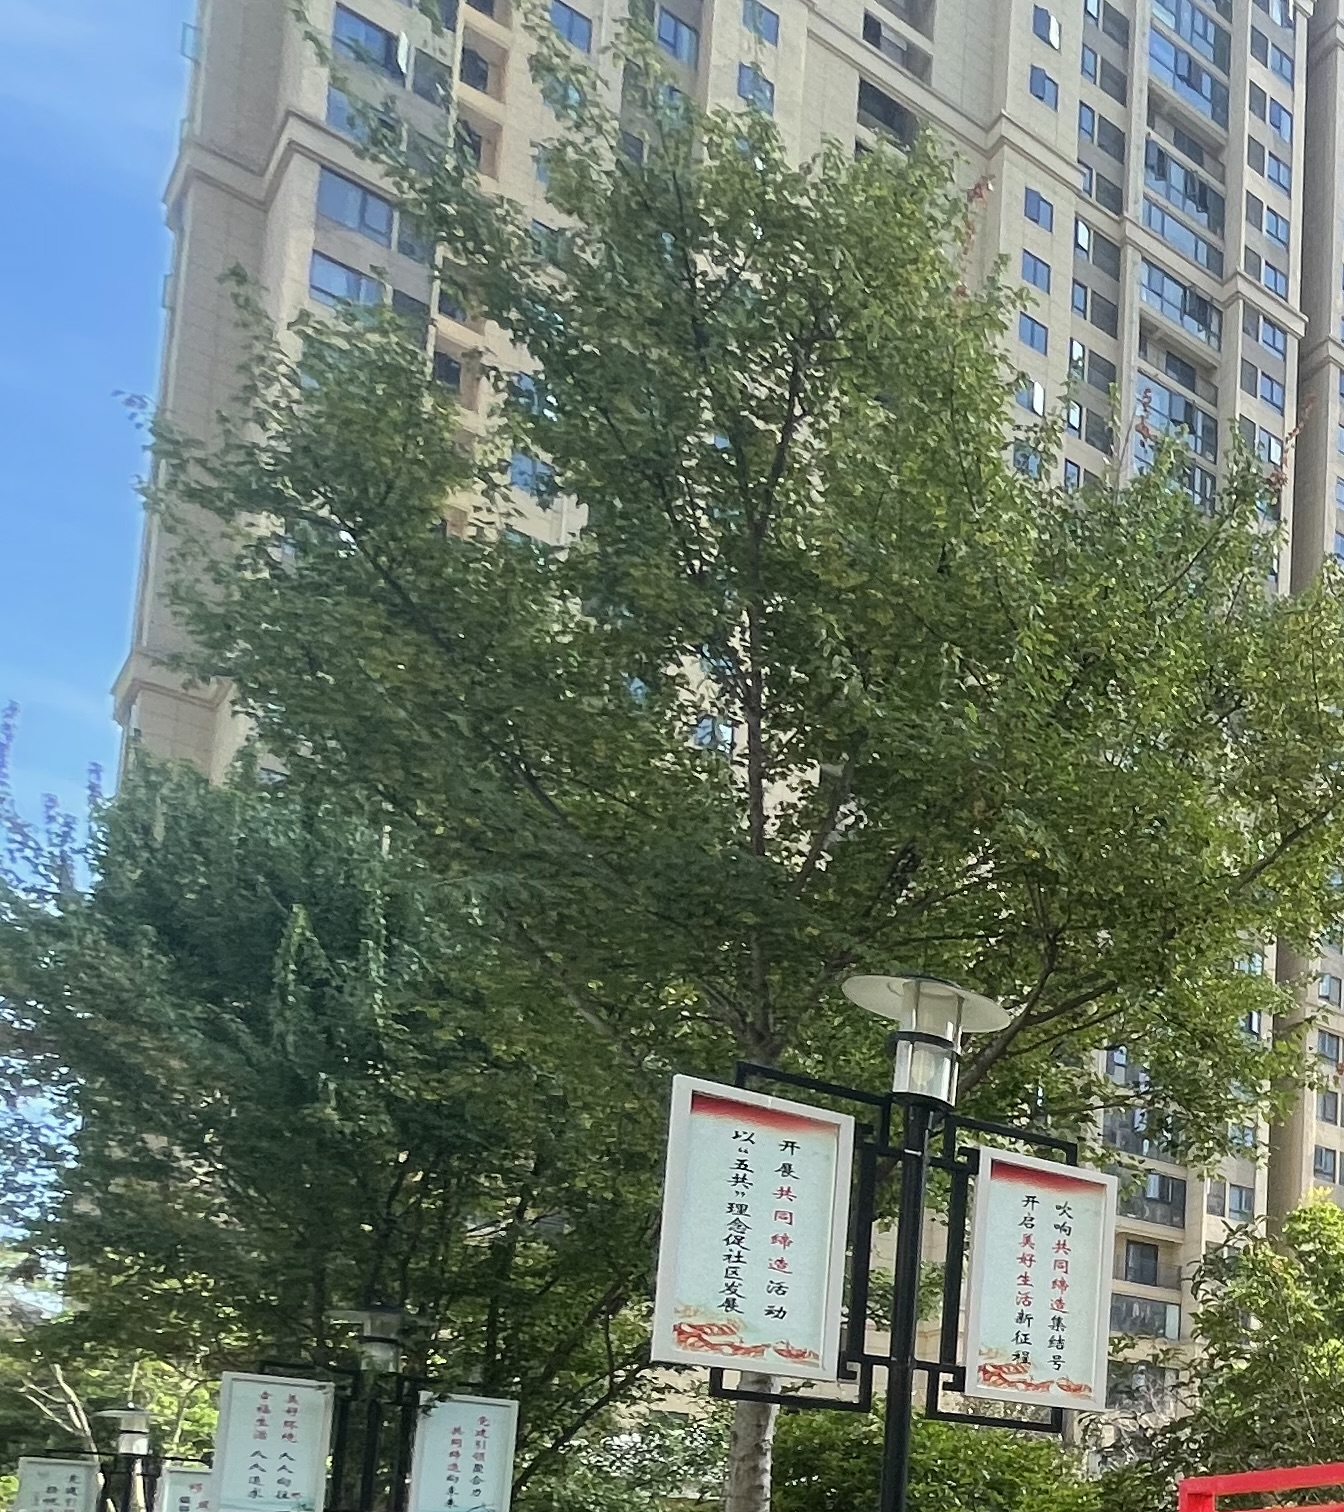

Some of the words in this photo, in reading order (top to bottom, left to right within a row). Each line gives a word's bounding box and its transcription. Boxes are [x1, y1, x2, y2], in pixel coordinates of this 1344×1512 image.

[764, 1140, 801, 1320] 开展共同缔造活动
[1011, 1195, 1040, 1366] 开启美好生活新征程
[1047, 1201, 1074, 1371] 吹响共同缔造集结号
